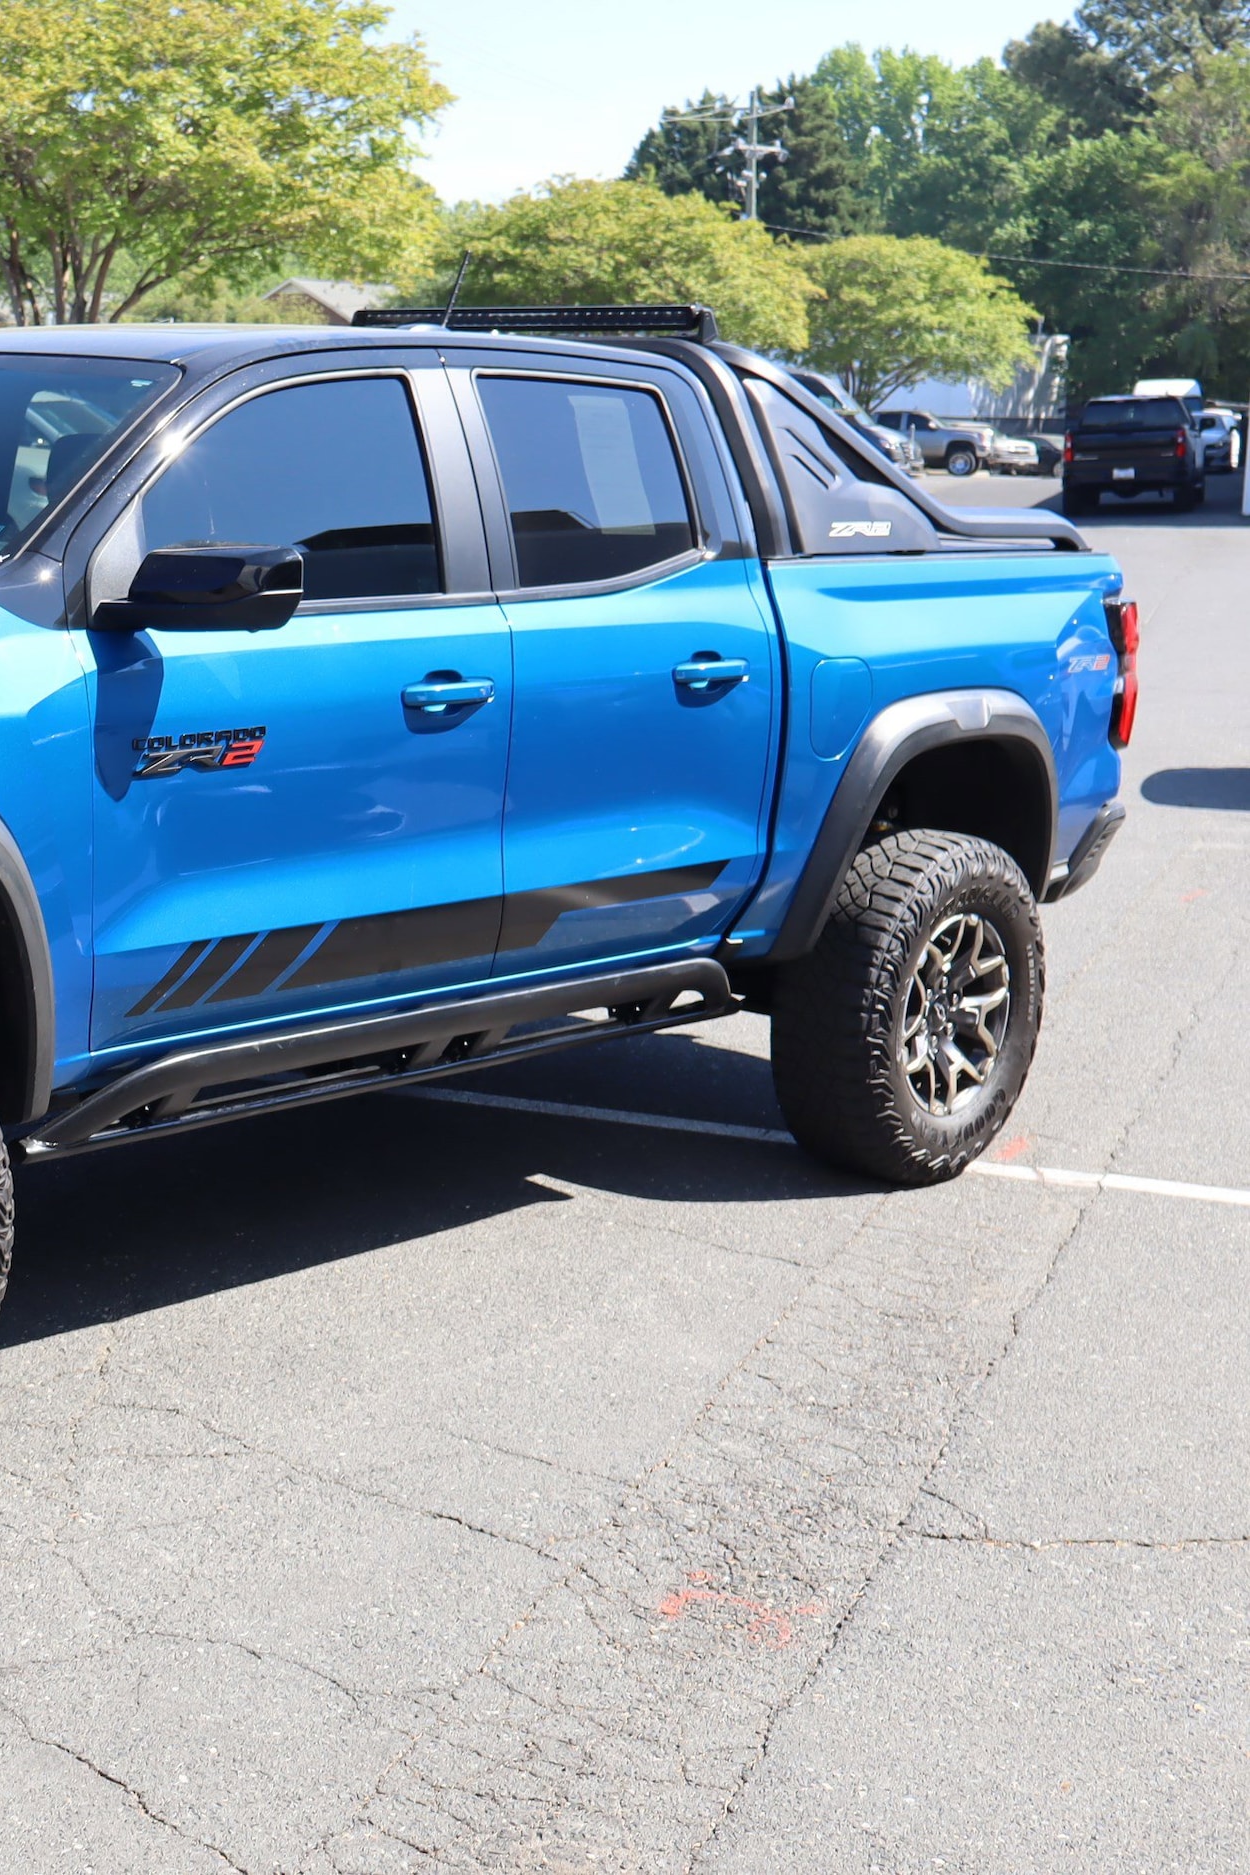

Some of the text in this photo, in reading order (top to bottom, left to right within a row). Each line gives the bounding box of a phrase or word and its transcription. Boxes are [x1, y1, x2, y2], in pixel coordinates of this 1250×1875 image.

[1067, 653, 1111, 673] ZR2
[132, 725, 266, 750] COLORADO
[133, 739, 265, 776] ZR2
